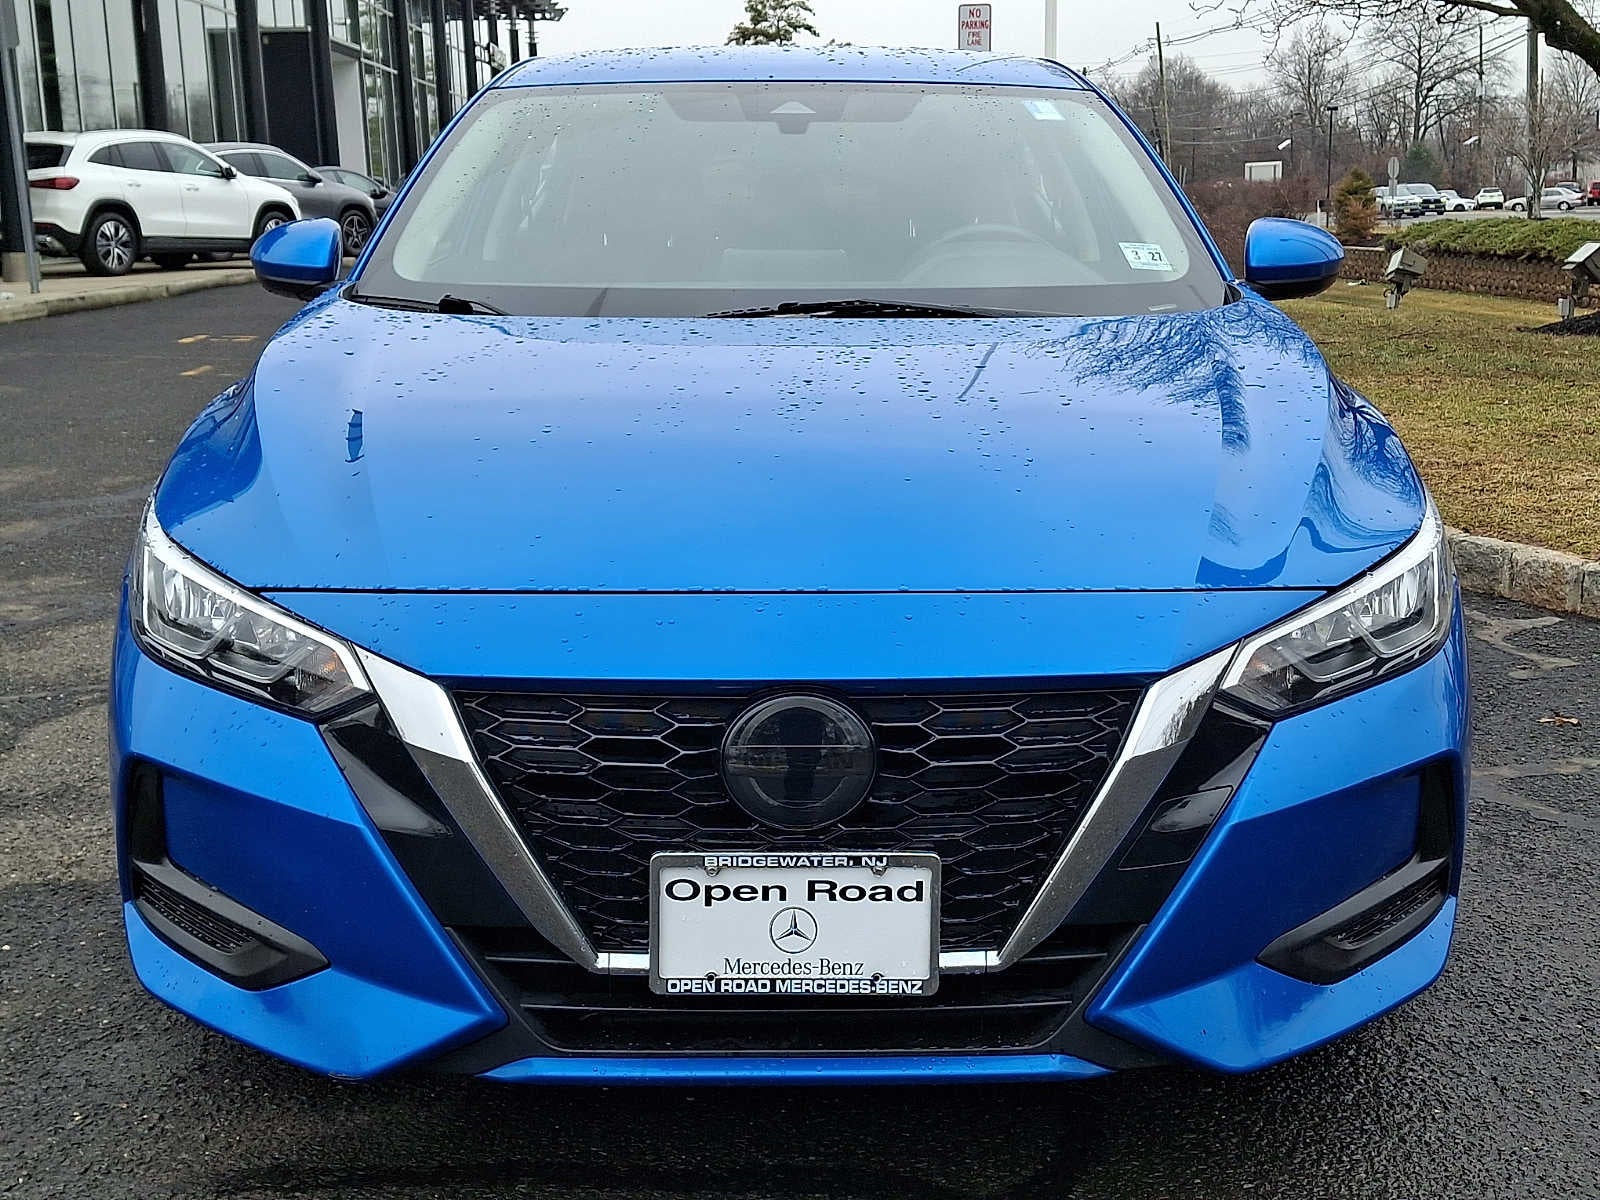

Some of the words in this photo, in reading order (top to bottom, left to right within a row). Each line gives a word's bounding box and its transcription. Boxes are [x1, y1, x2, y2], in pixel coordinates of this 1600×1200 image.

[969, 8, 981, 18] NO
[961, 20, 989, 30] PARKING
[1131, 250, 1141, 260] 3
[1148, 252, 1163, 261] 27
[861, 856, 888, 867] NJ
[664, 878, 788, 907] Open
[807, 880, 924, 902] Road
[723, 958, 864, 976] Mercedes-Benz
[667, 980, 716, 994] OPEN
[720, 980, 770, 994] ROAD
